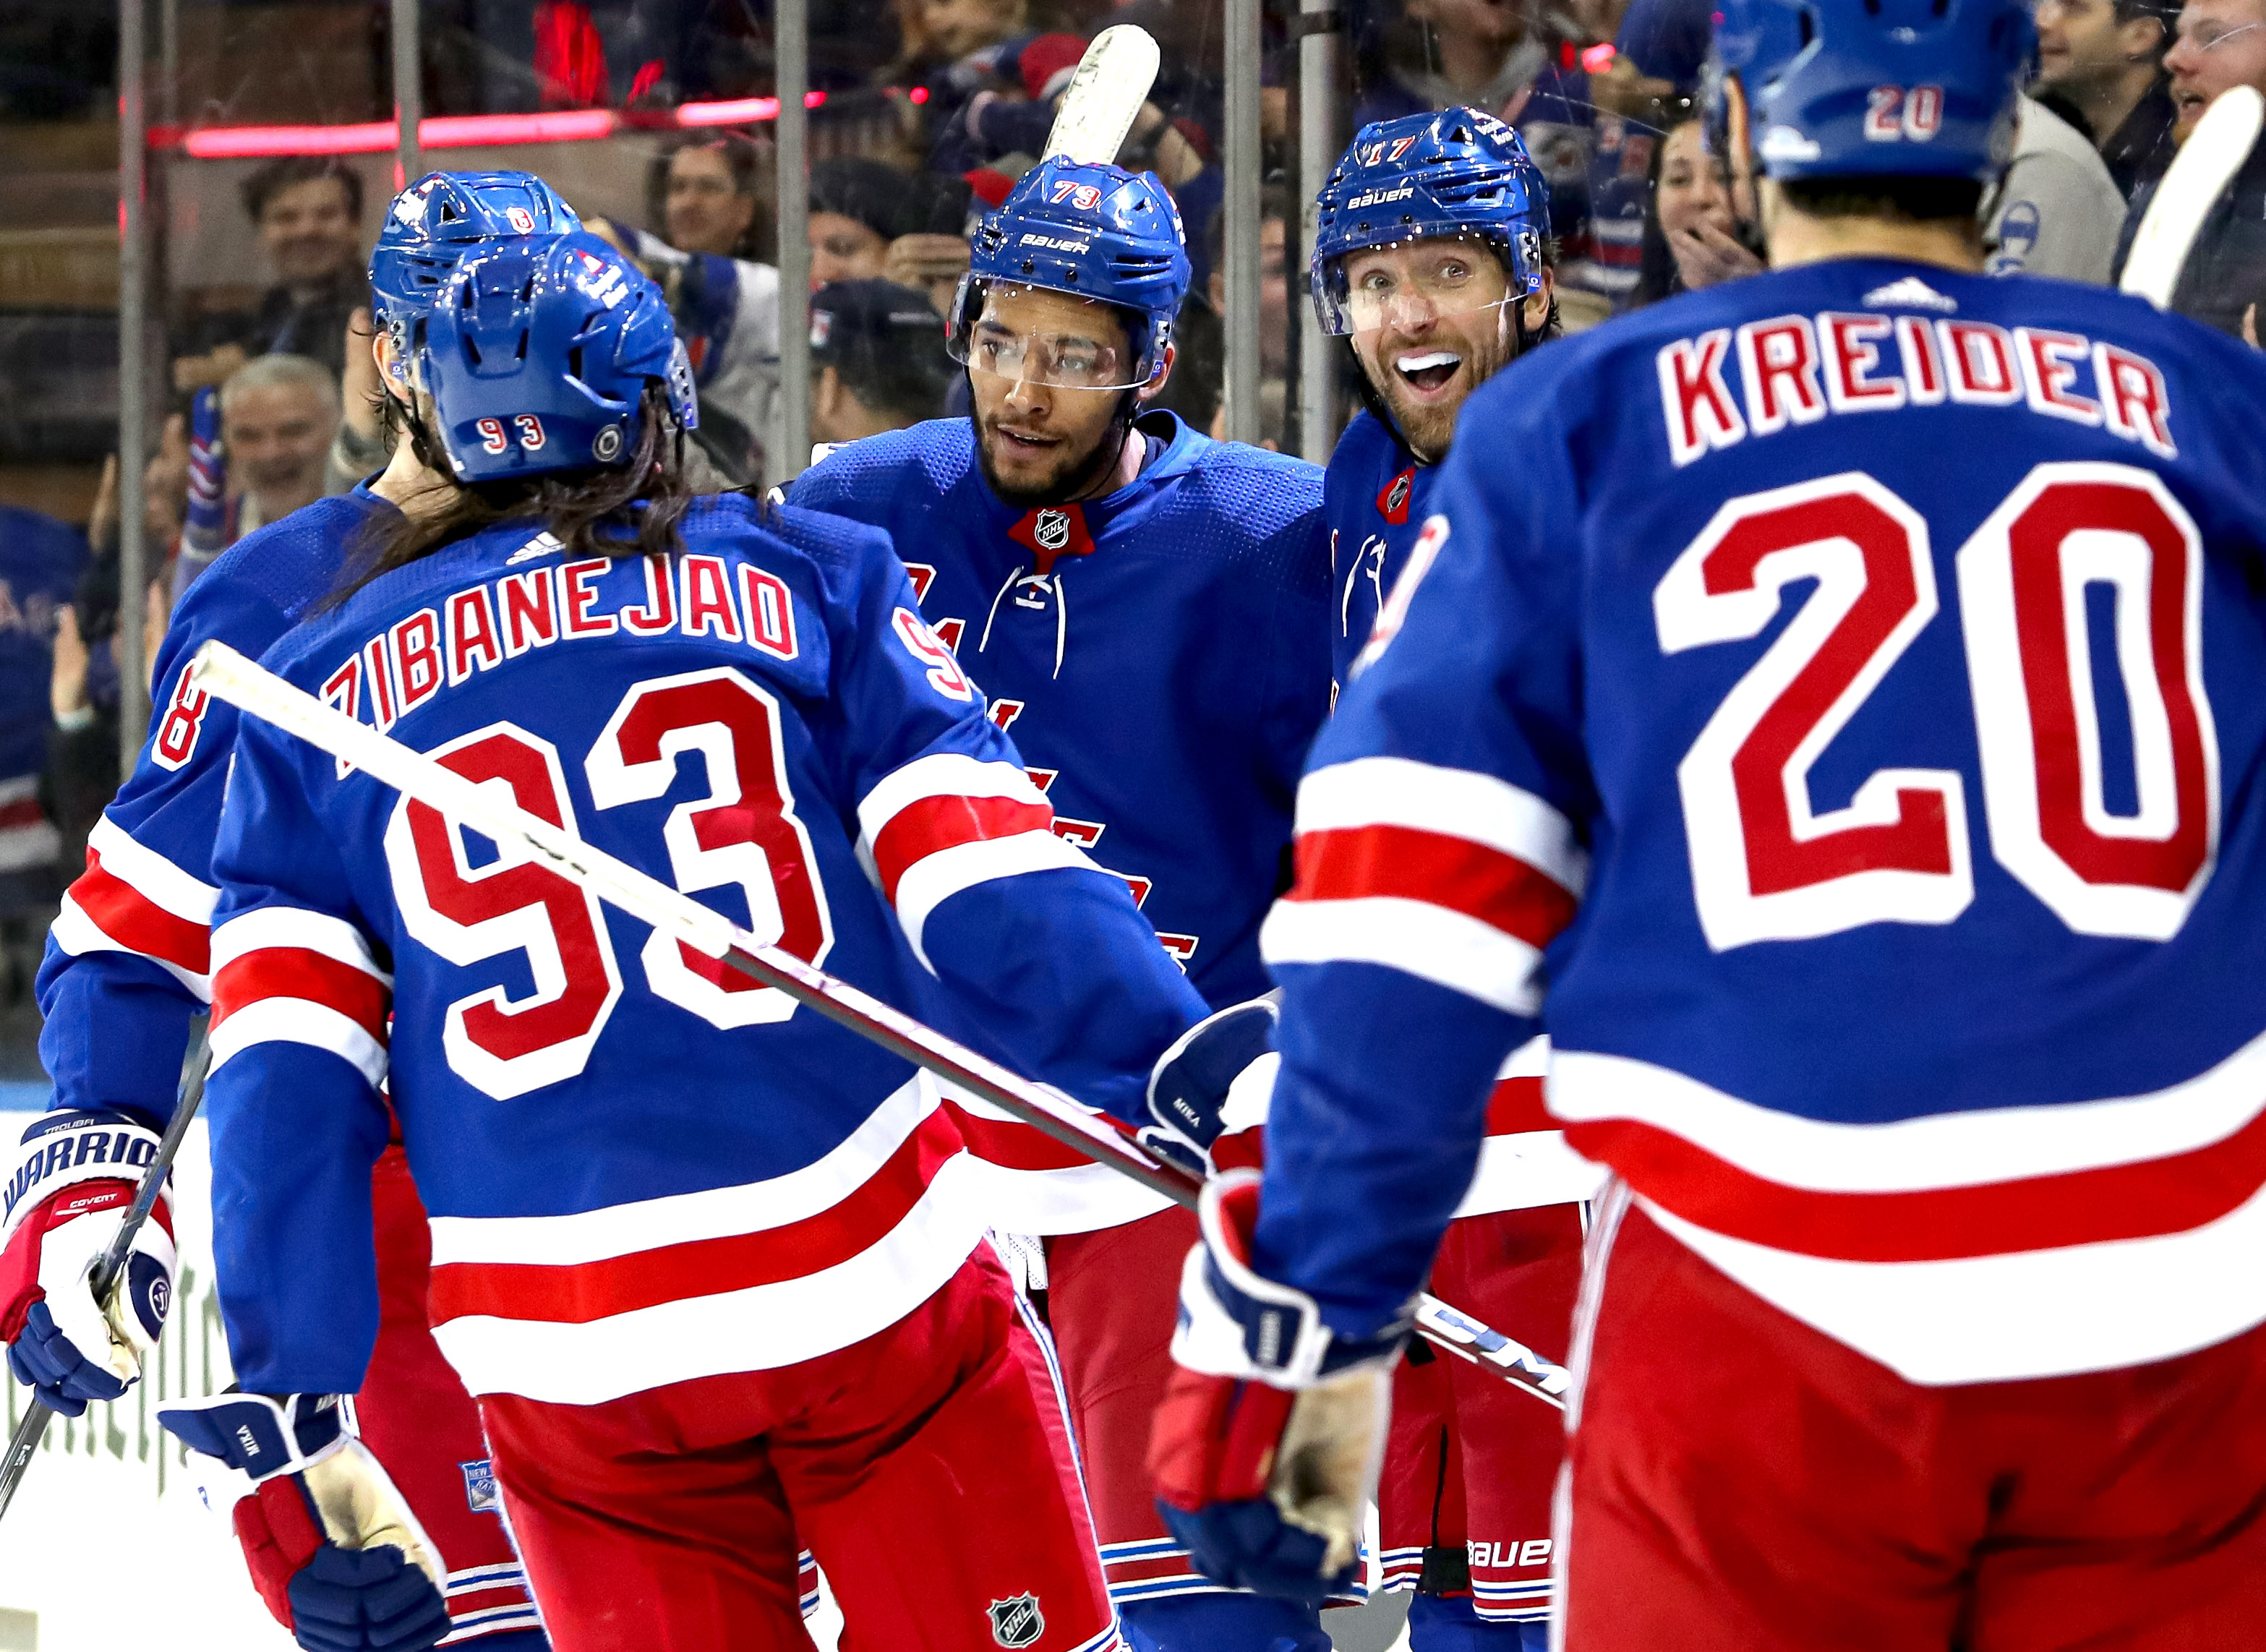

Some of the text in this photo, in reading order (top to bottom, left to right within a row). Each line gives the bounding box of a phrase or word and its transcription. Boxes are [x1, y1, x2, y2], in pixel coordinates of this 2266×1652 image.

[1863, 85, 1944, 142] 20
[1364, 136, 1416, 168] 17
[1049, 180, 1103, 210] 79
[1656, 312, 2179, 467] KREIDER
[476, 414, 547, 455] 93
[1042, 521, 1063, 539] NHL
[318, 552, 799, 781] ZIBANEJAD
[151, 656, 212, 771] 8
[1652, 470, 2223, 953] 20
[382, 665, 835, 1102] 93
[1173, 1097, 1201, 1128] MIKA
[3, 1132, 174, 1228] WARRIO
[69, 1193, 118, 1208] COVERT
[236, 1424, 261, 1458] MIKA
[1004, 1606, 1032, 1640] NHL
